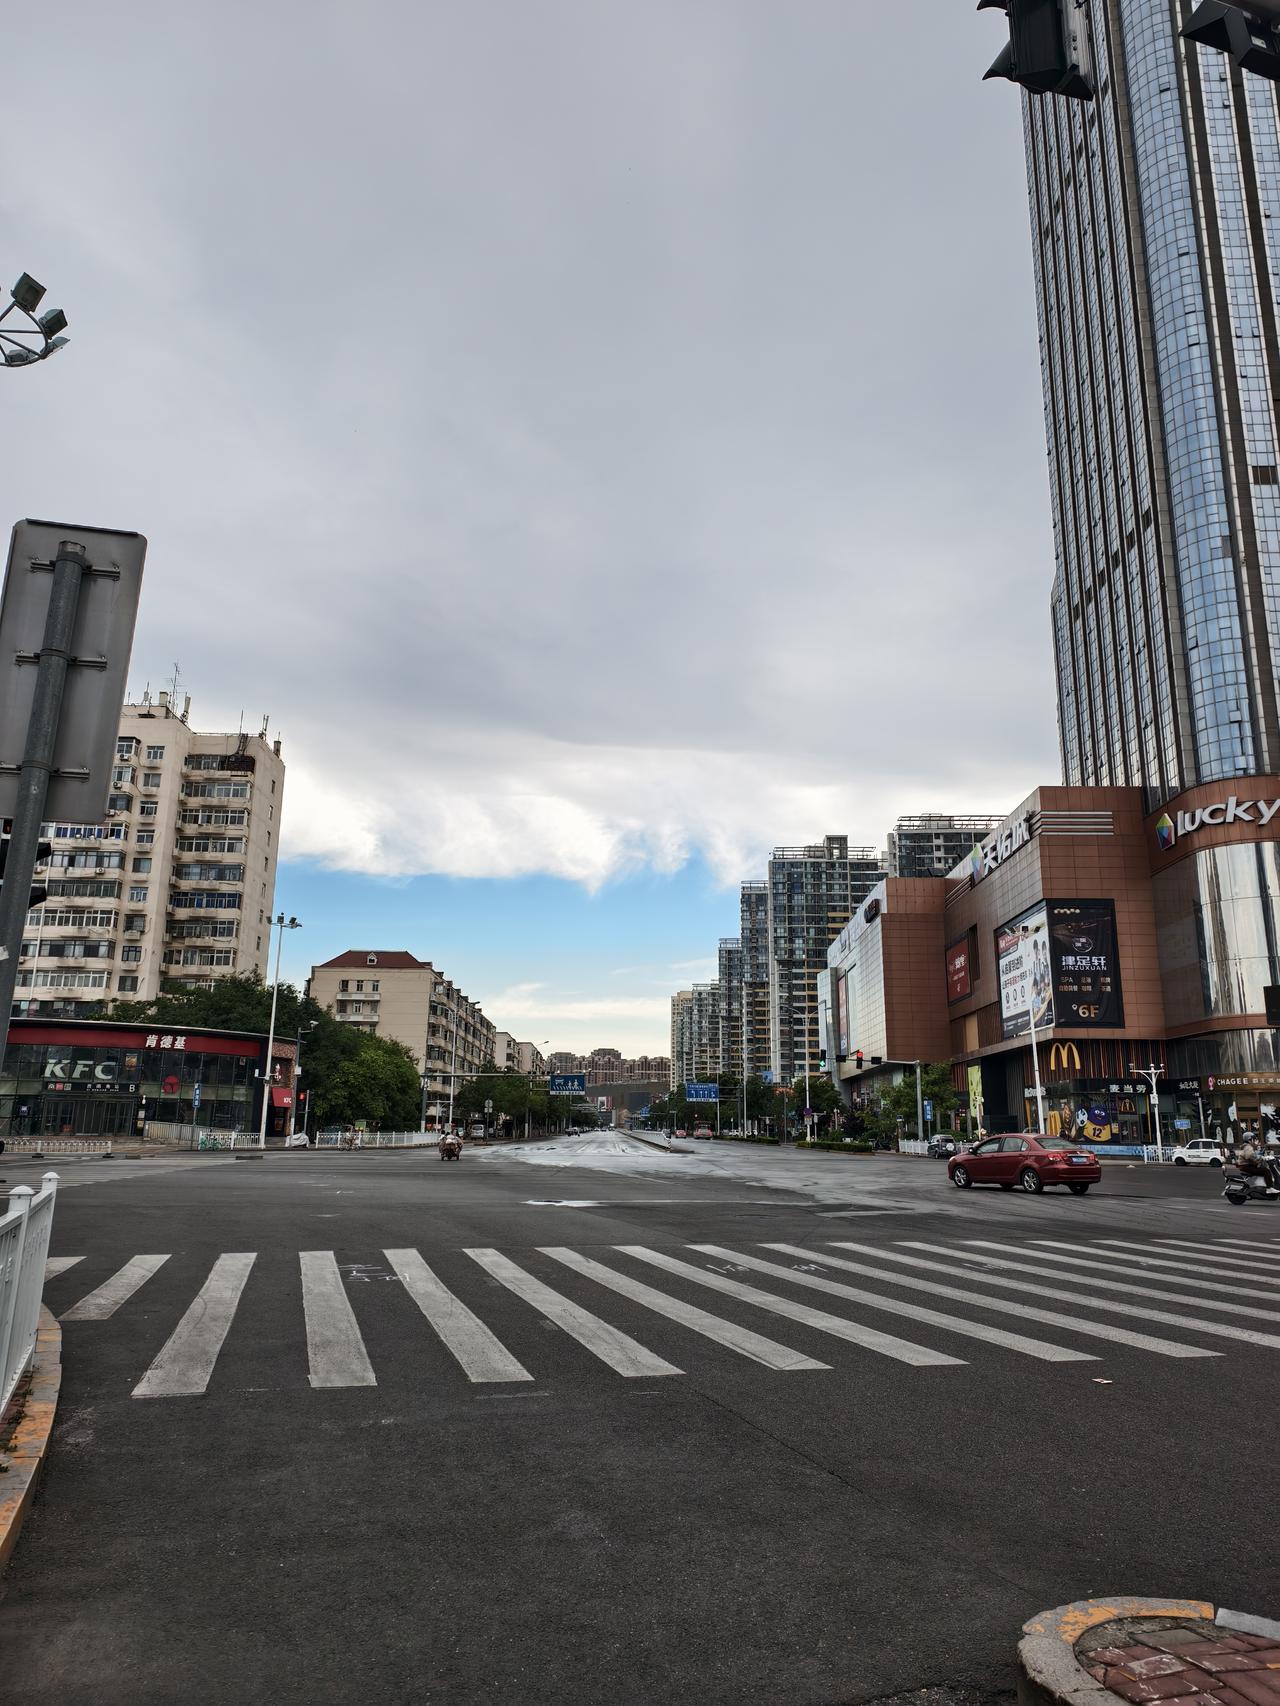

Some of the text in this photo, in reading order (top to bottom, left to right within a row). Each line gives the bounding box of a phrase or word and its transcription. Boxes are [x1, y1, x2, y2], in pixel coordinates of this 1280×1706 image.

[1177, 796, 1280, 837] lucky
[1061, 955, 1107, 966] 津足轩
[1078, 1004, 1099, 1018] 6F
[145, 1034, 187, 1050] 肯德基
[43, 1059, 117, 1080] KFC
[1109, 1084, 1147, 1093] 麦当劳
[1216, 1077, 1249, 1086] CHAGEE
